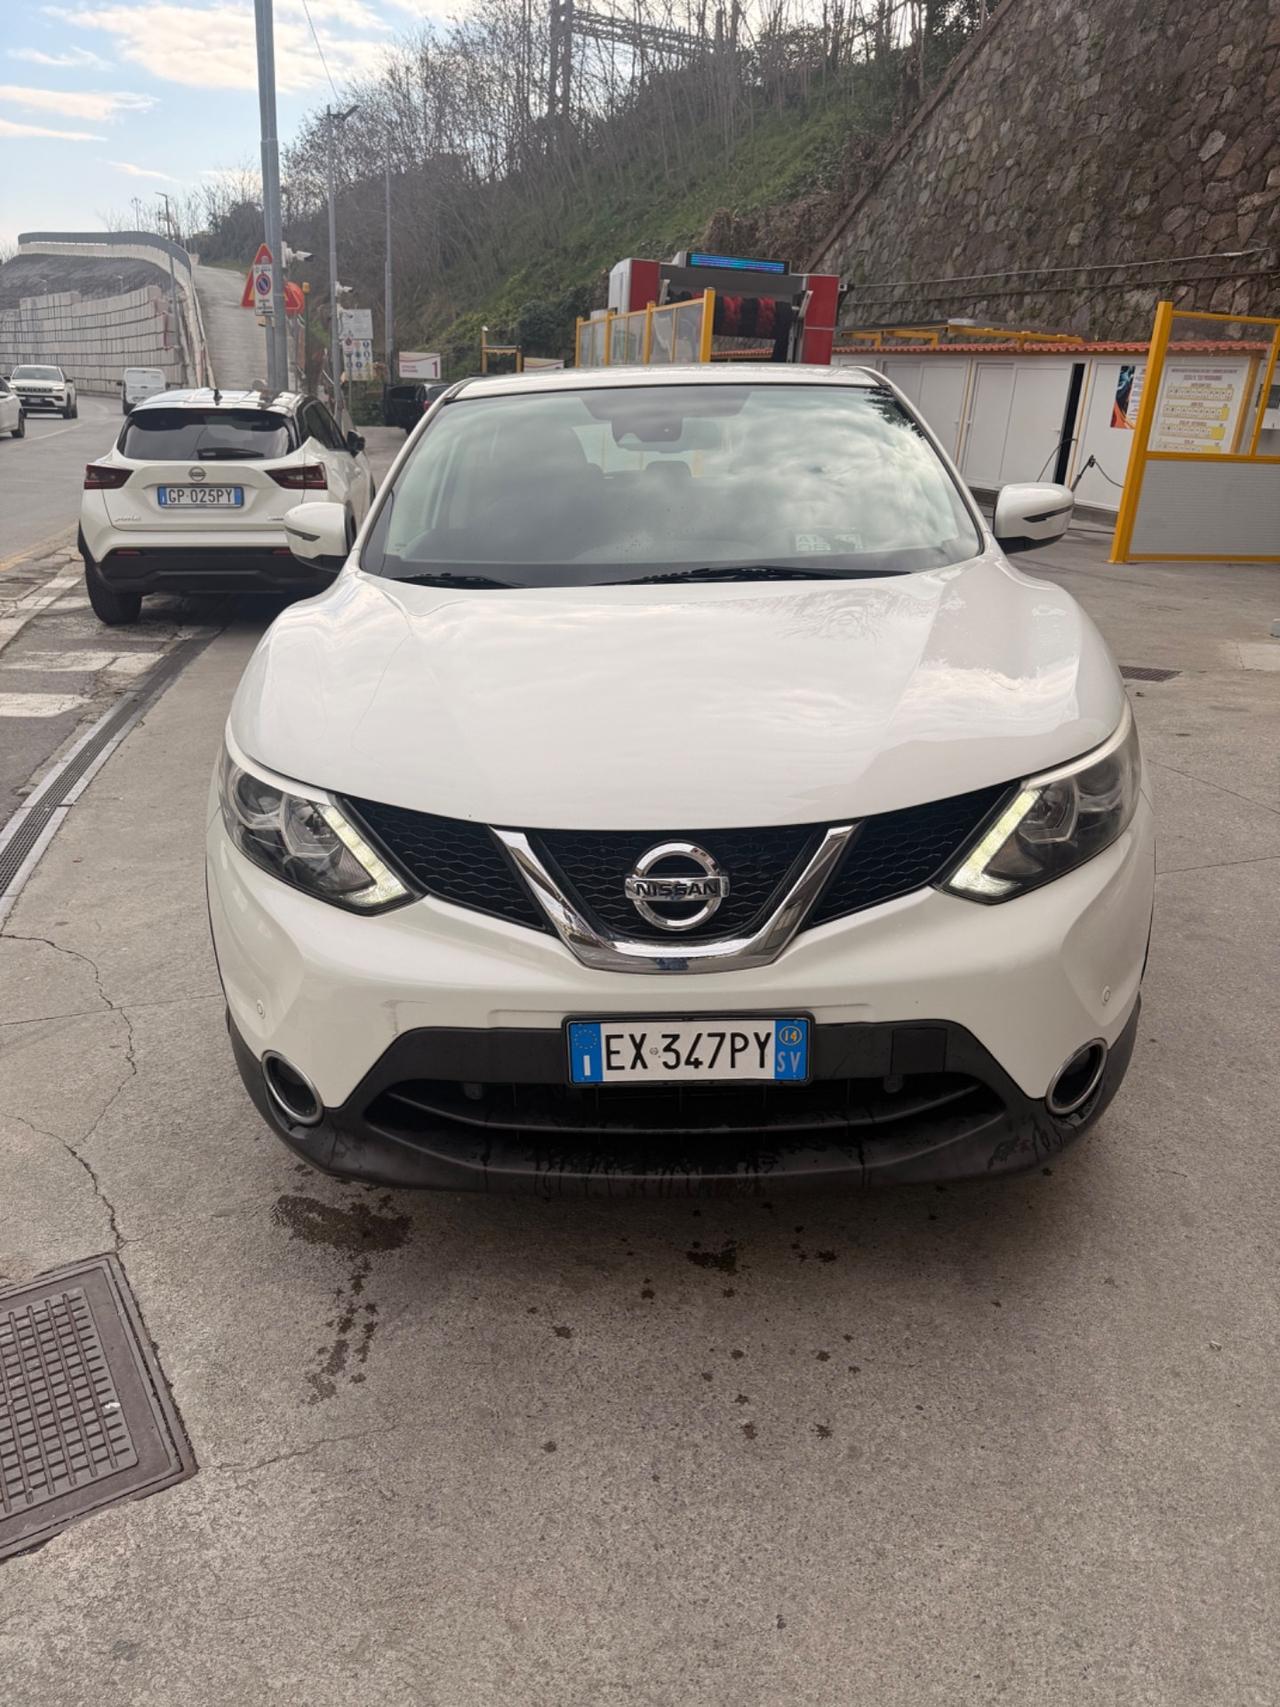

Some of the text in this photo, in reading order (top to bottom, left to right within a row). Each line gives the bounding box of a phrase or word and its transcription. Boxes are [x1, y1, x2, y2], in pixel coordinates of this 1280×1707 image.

[432, 360, 438, 378] 1
[635, 883, 718, 897] NISSAN
[783, 1030, 797, 1042] 14
[583, 1032, 772, 1076] I EX 347PY
[777, 1051, 802, 1073] SV
